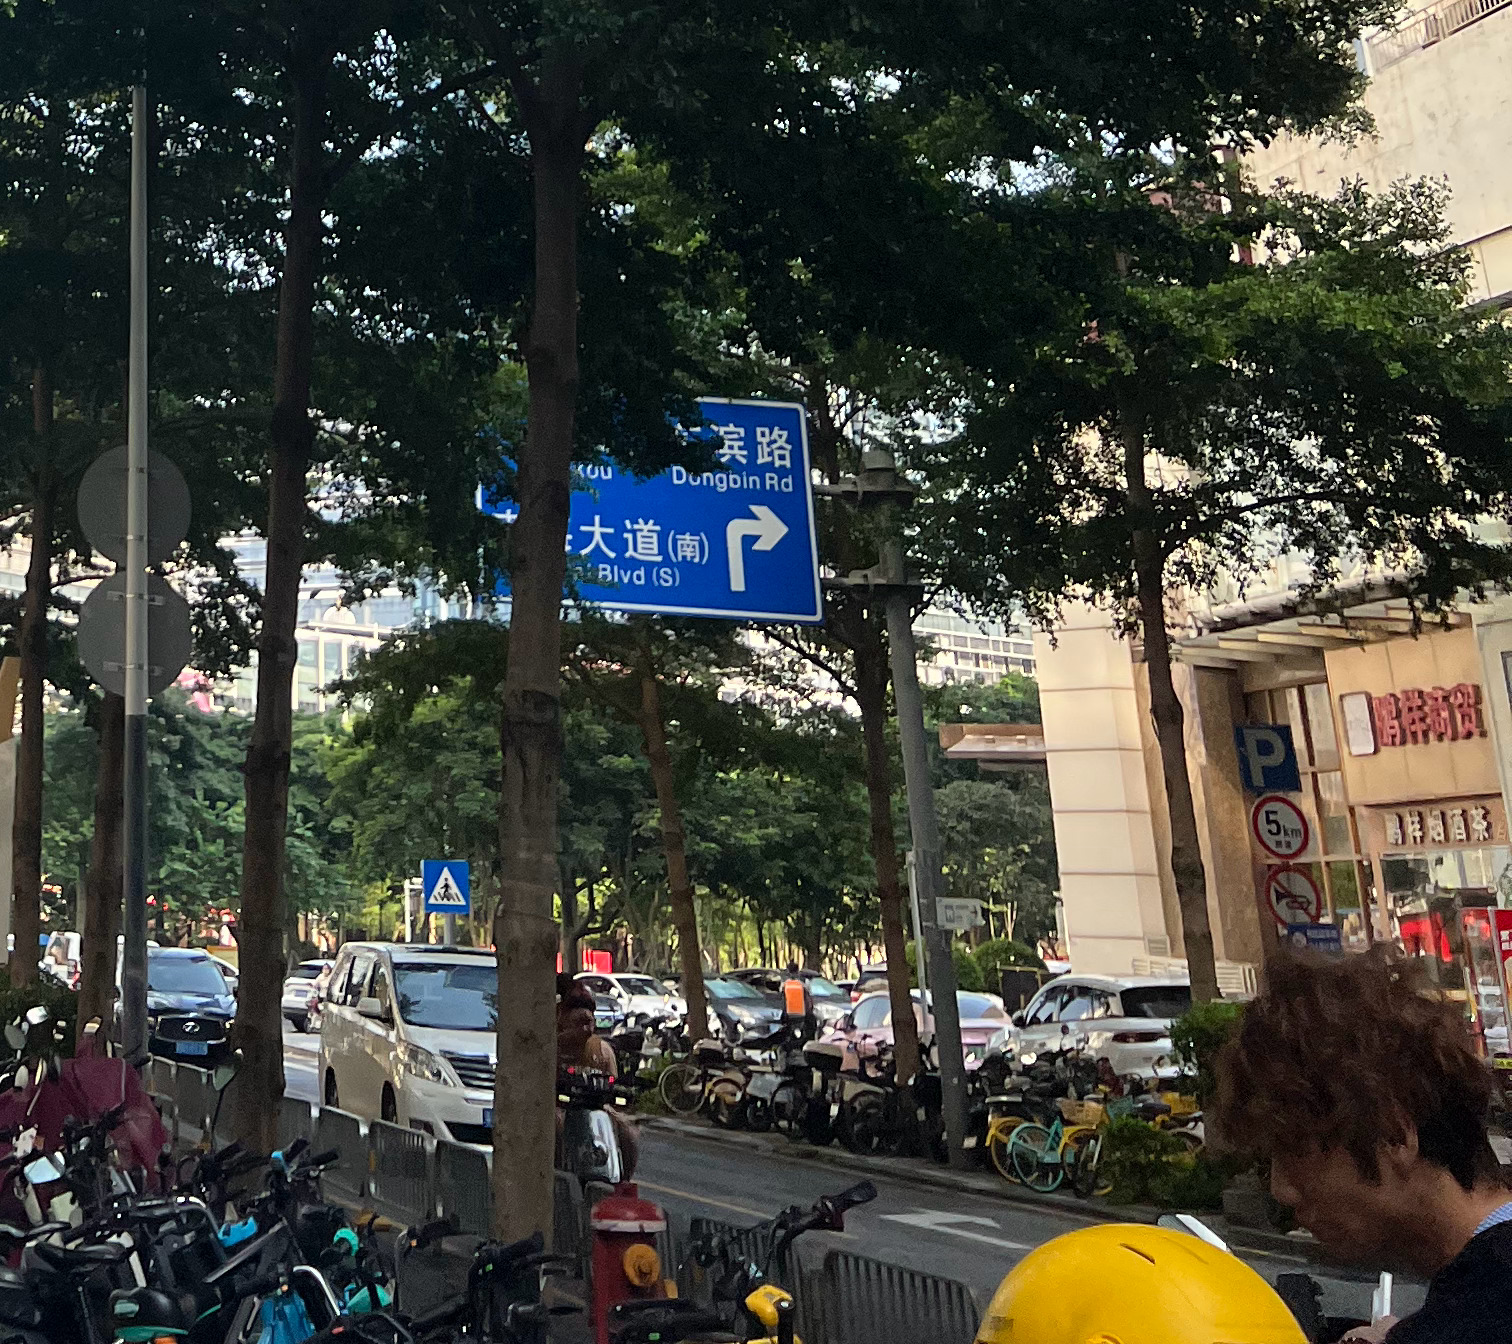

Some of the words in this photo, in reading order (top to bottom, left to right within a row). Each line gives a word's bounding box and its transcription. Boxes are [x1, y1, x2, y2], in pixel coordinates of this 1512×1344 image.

[674, 422, 792, 469] 滨路
[765, 472, 793, 493] Rd
[598, 563, 645, 586] Blvd
[651, 566, 681, 587] (S)
[1244, 728, 1286, 788] P
